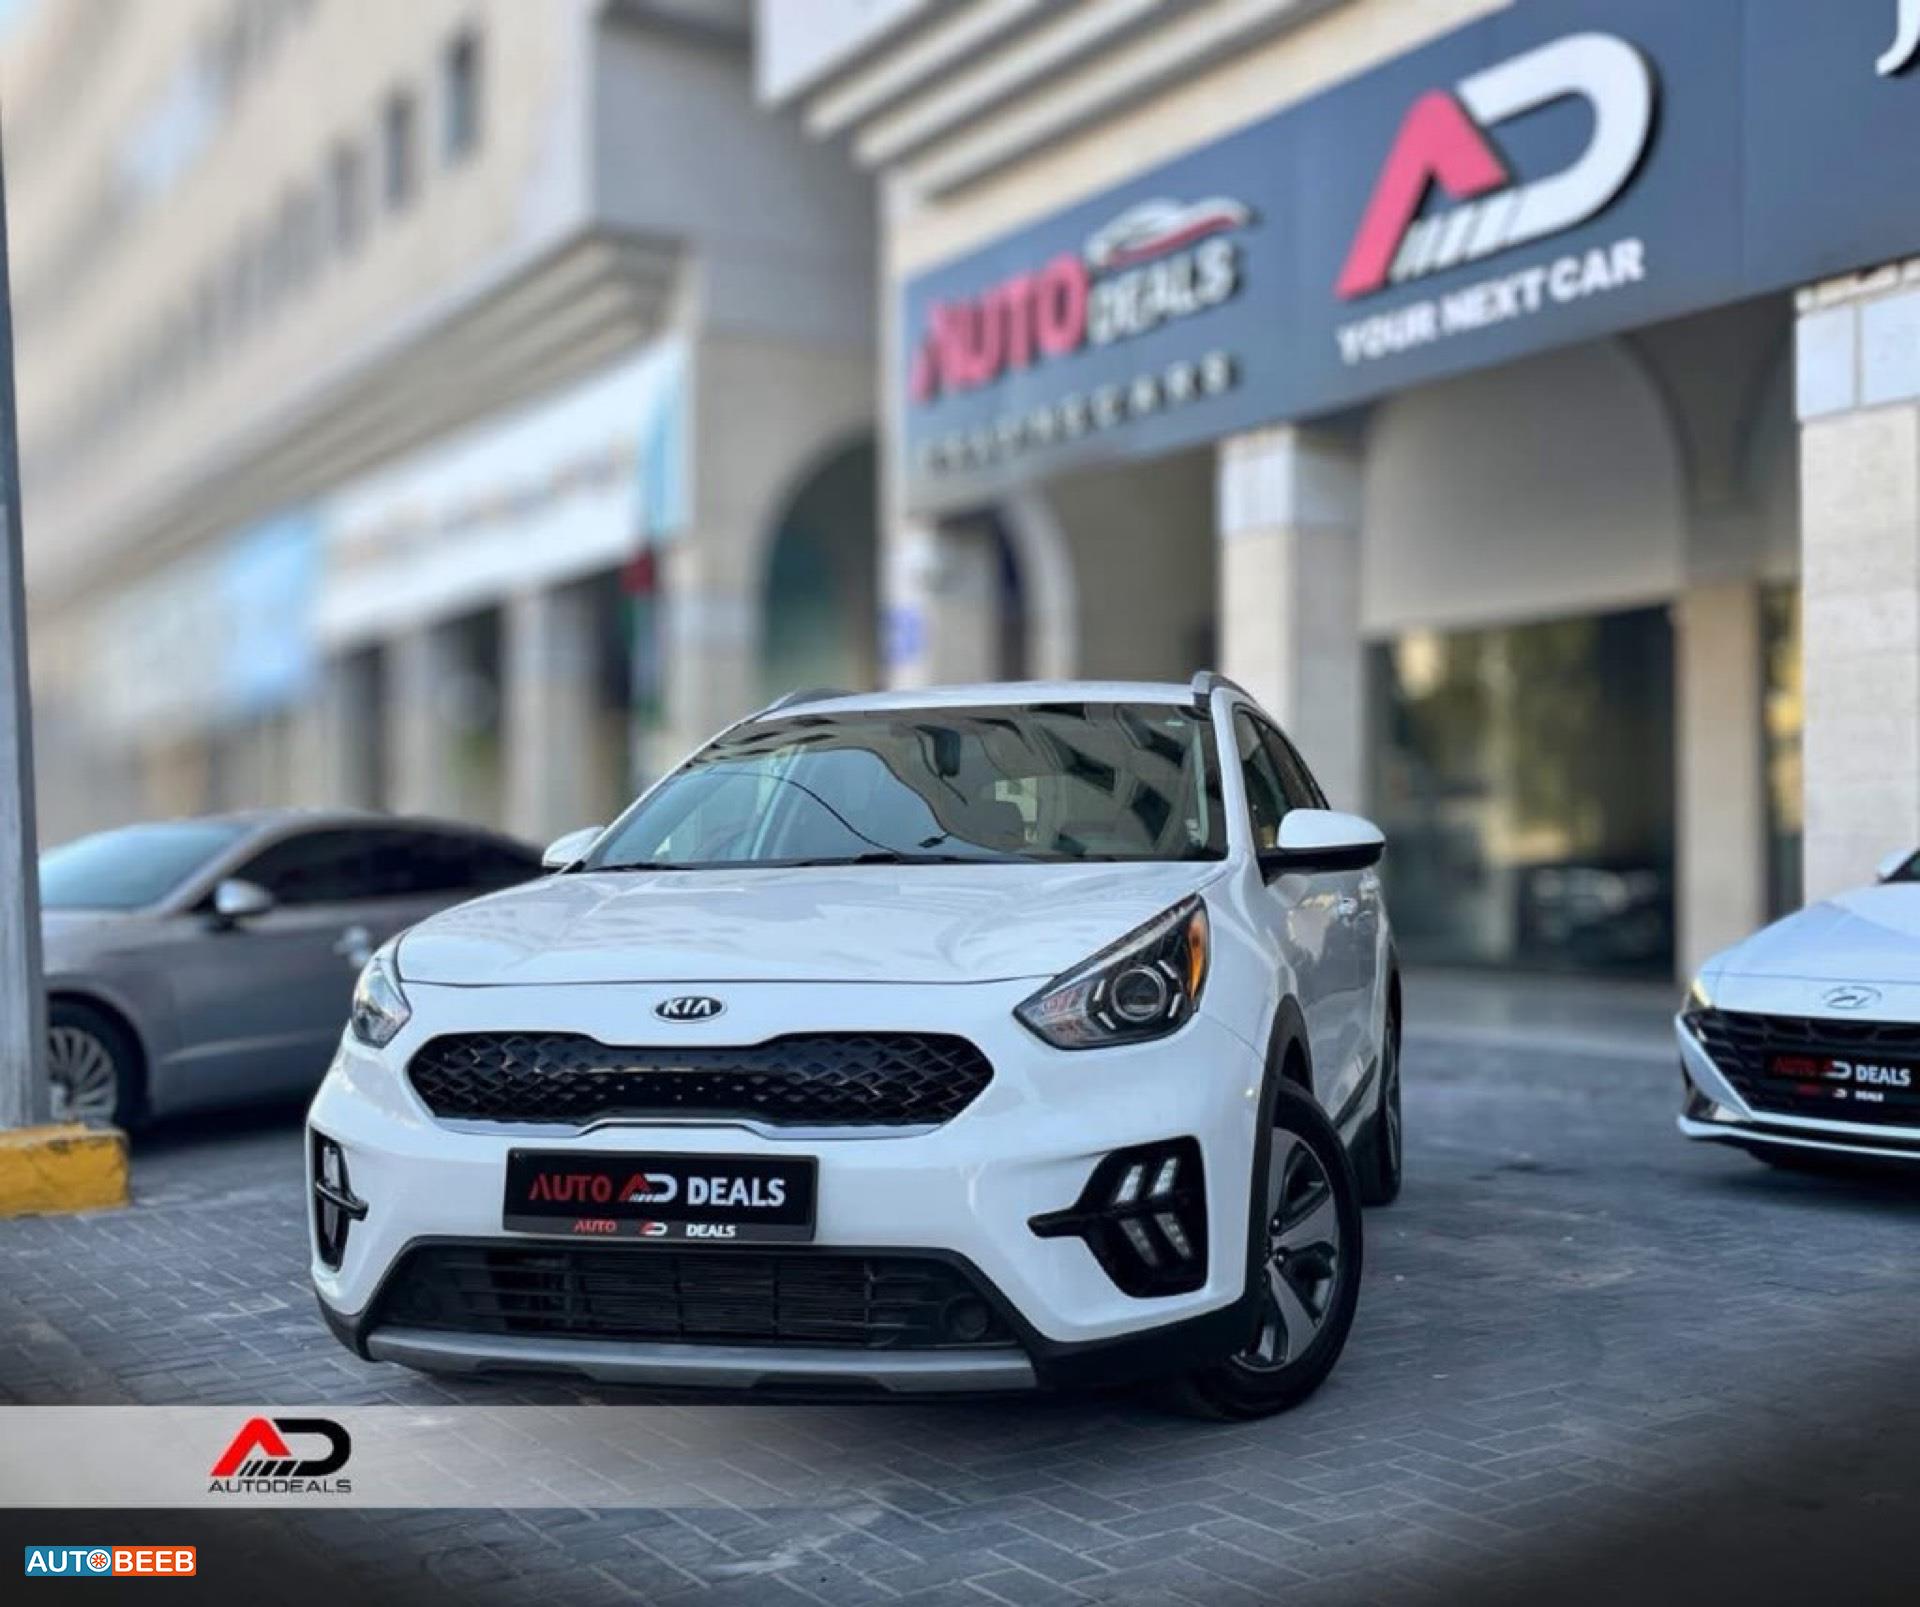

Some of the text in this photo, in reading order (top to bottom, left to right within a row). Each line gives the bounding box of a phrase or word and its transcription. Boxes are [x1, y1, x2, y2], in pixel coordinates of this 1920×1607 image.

[1337, 237, 1644, 365] YOUR NEXT CAR
[908, 238, 1236, 402] AUTO DEALS
[663, 999, 711, 1015] KIA
[1855, 1064, 1911, 1087] DEALS
[530, 1174, 611, 1200] AUTO
[687, 1177, 785, 1206] DEALS
[574, 1219, 617, 1233] AUTO
[685, 1224, 736, 1238] DEALS
